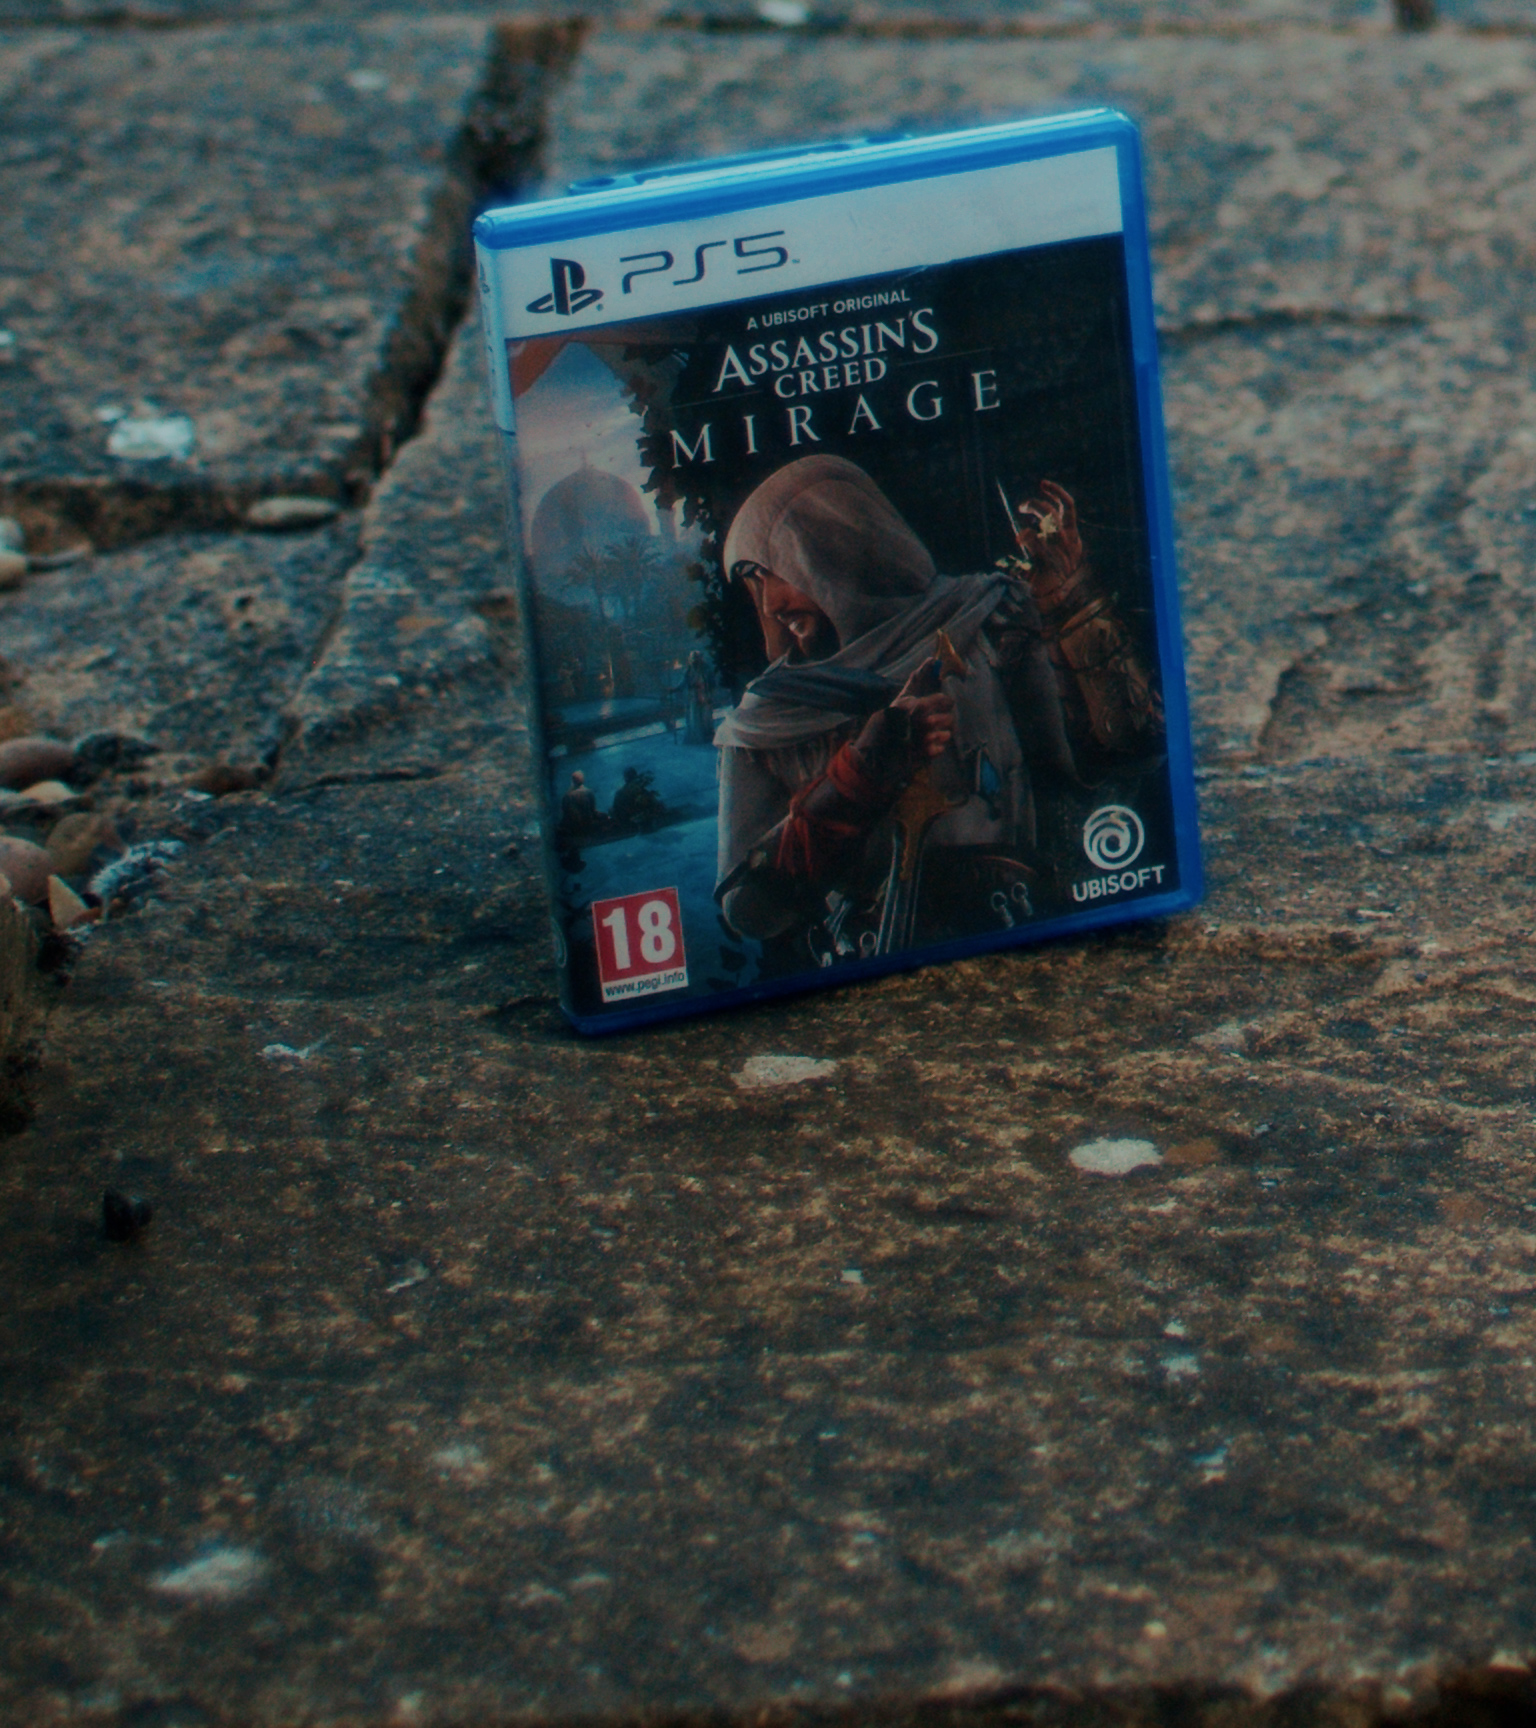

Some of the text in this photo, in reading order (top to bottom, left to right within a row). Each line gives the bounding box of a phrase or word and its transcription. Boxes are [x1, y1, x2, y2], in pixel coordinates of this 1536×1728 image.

[620, 230, 788, 294] PS5
[746, 289, 911, 331] A UBISOFT ORIGINAL
[713, 307, 939, 393] ASSASSIN'S
[774, 357, 888, 399] CREED
[669, 370, 1001, 469] MIRAGE
[1072, 864, 1165, 902] UBISOFT
[602, 900, 675, 970] 18
[605, 970, 685, 997] www.pegi.info
